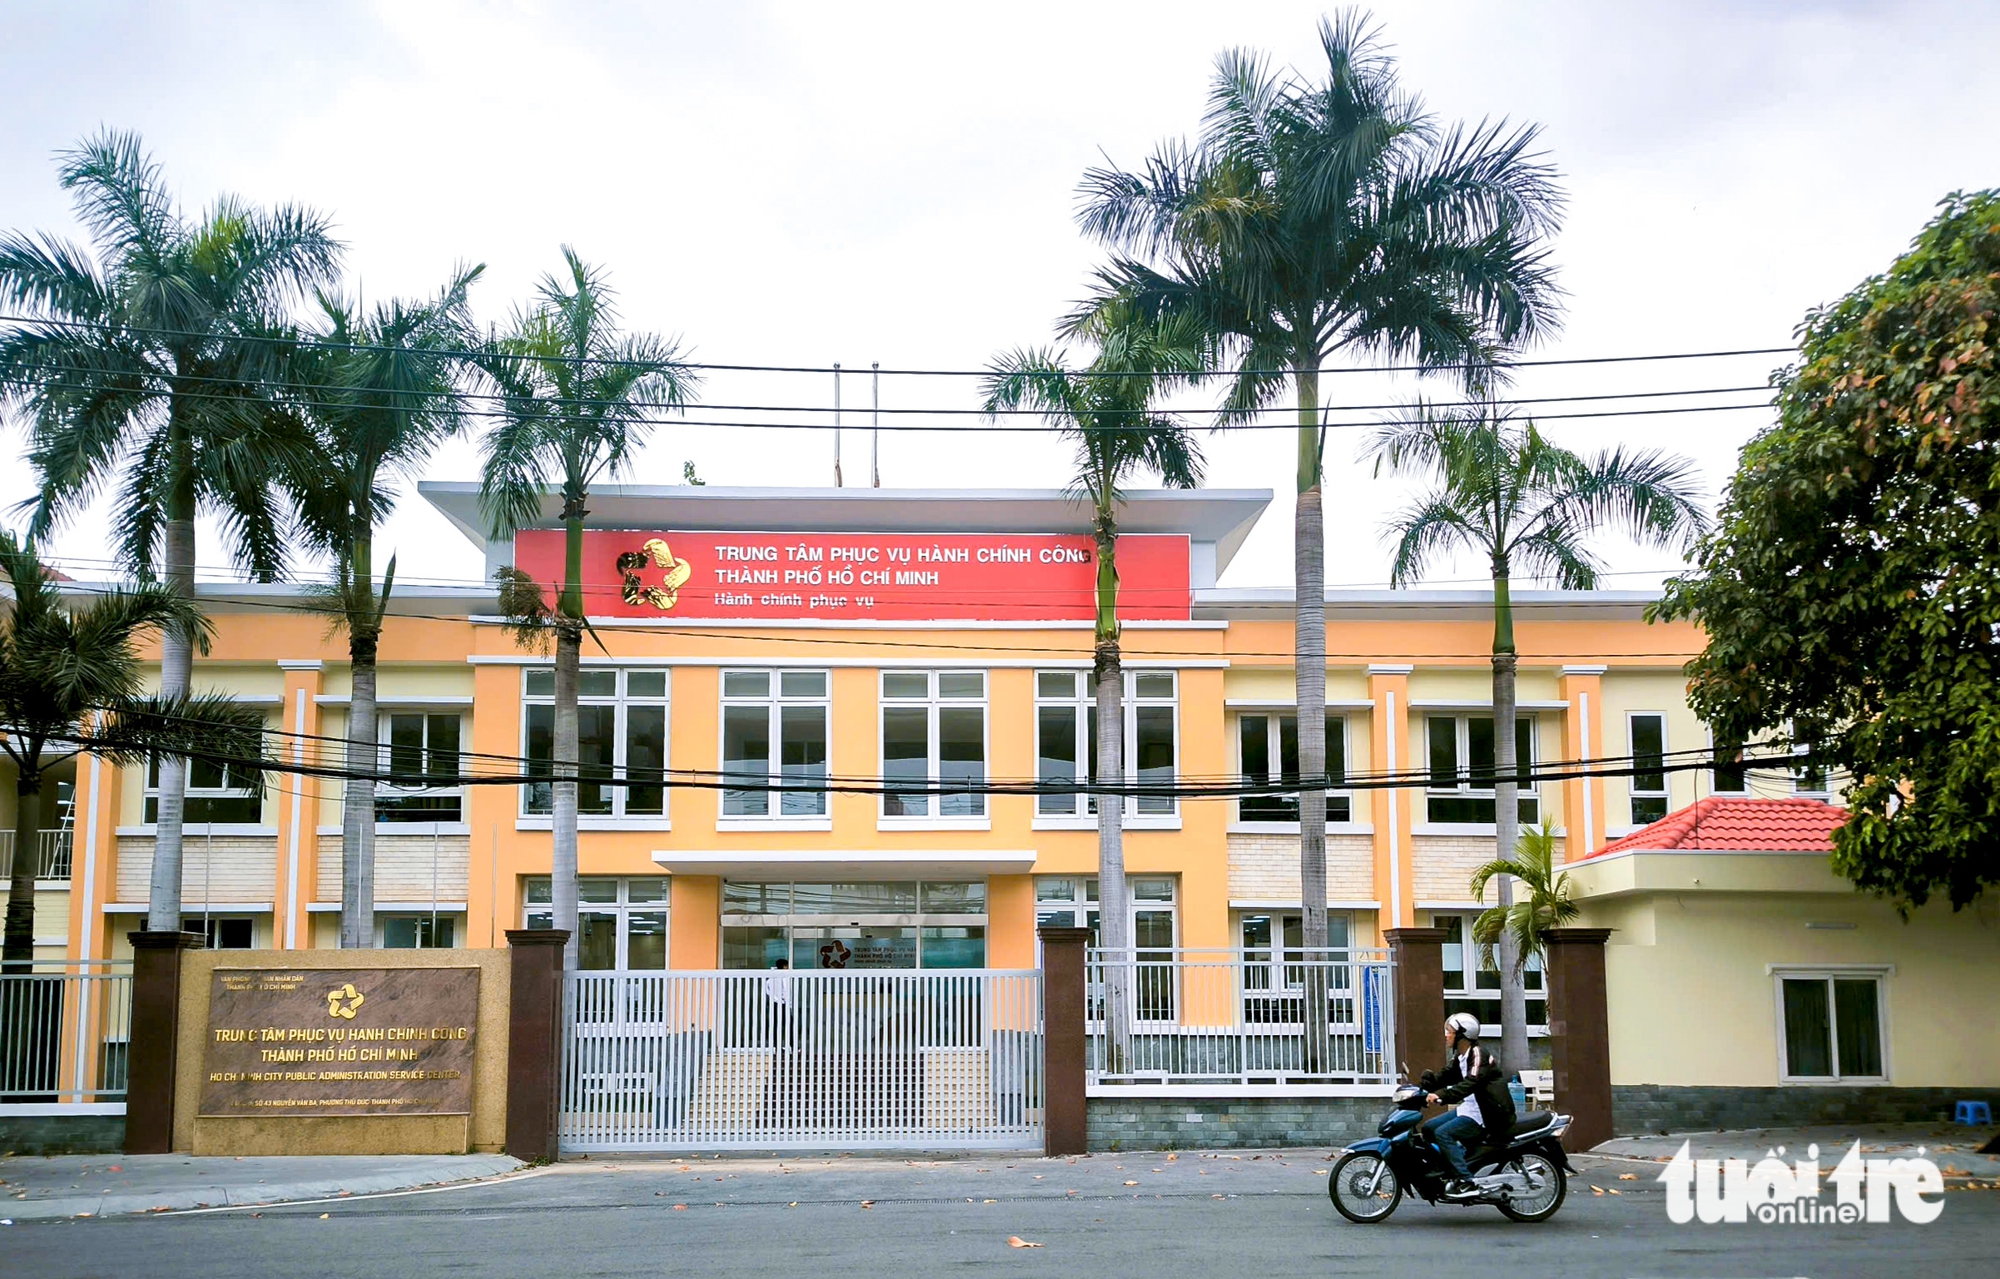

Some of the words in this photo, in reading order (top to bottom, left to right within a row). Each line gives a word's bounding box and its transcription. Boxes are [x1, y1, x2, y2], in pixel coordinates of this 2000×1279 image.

[714, 546, 778, 561] TRUNG
[785, 543, 823, 561] TÂM
[830, 547, 880, 566] PHỤC
[886, 547, 911, 566] VỤ
[917, 544, 969, 563] HÀNH
[976, 544, 1032, 563] CHÍNH
[1039, 544, 1092, 563] CÔNG
[714, 566, 778, 584] THÀNH
[784, 565, 822, 585] PHỐ
[828, 564, 854, 585] HỒ
[860, 567, 891, 585] CHÍ
[895, 571, 939, 585] MINH
[714, 592, 753, 605] Hành
[760, 593, 802, 606] chính
[810, 594, 847, 610] phục
[855, 596, 874, 610] vụ
[260, 1026, 285, 1042] TÂM
[289, 1028, 325, 1044] PHỤC
[327, 1028, 345, 1044] VỤ
[261, 1046, 304, 1062] THÀNH
[307, 1045, 335, 1062] PHỐ
[360, 1045, 383, 1061] CHÍ
[386, 1048, 418, 1061] MINH
[264, 1072, 282, 1081] CITY
[285, 1071, 317, 1081] PUBLIC
[318, 1071, 389, 1080] ADMINISTRATION
[389, 1070, 425, 1080] SERVICE
